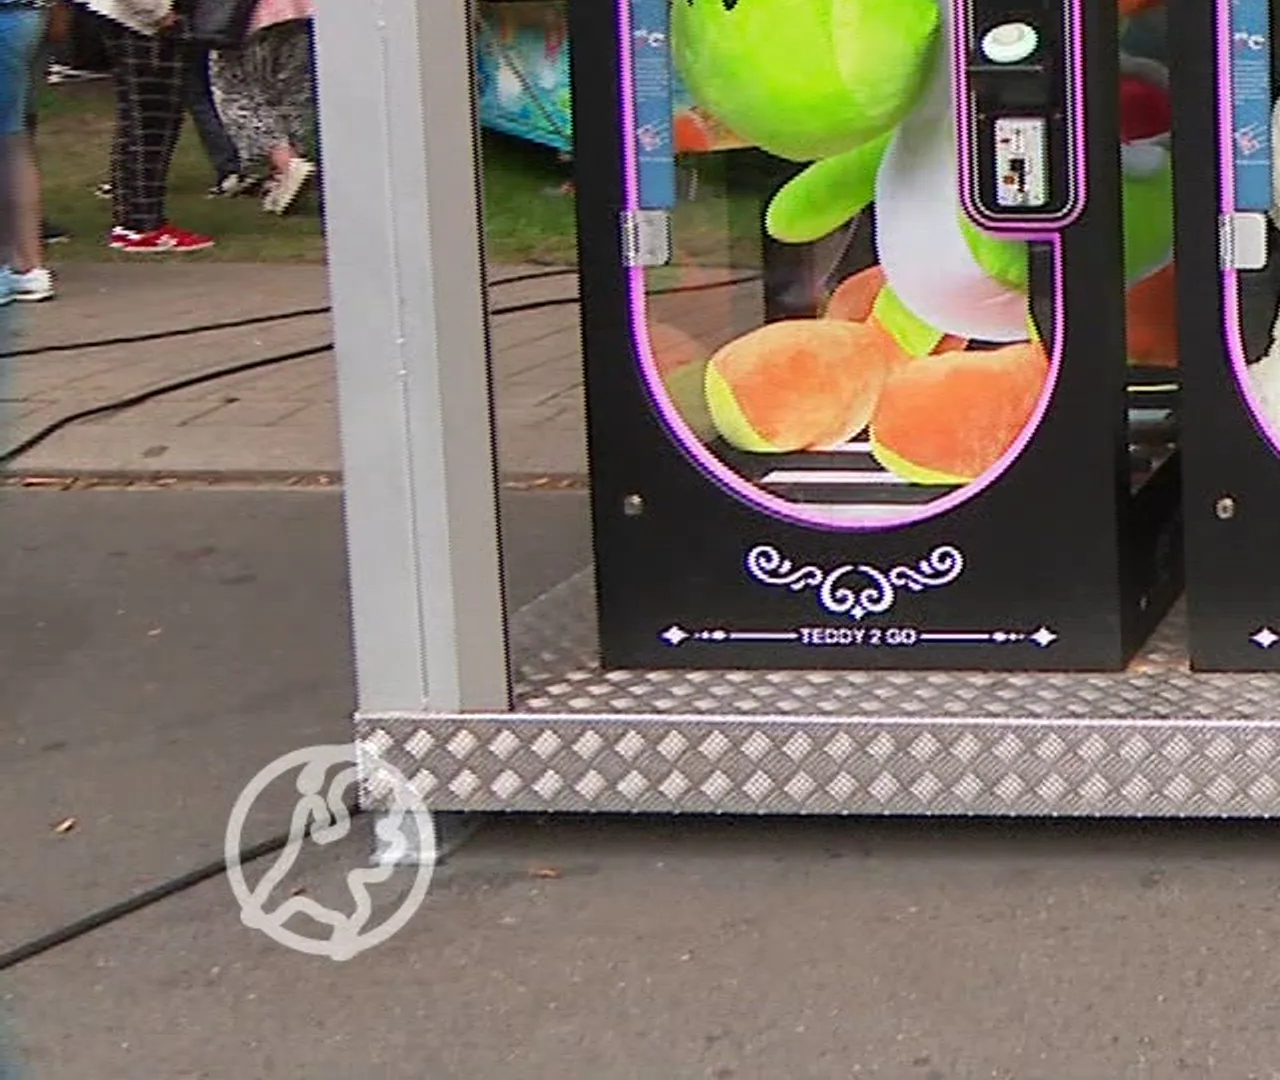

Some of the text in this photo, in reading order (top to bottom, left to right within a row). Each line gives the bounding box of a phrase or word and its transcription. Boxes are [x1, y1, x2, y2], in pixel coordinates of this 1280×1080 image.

[799, 627, 917, 645] TEDDY 2 GO
